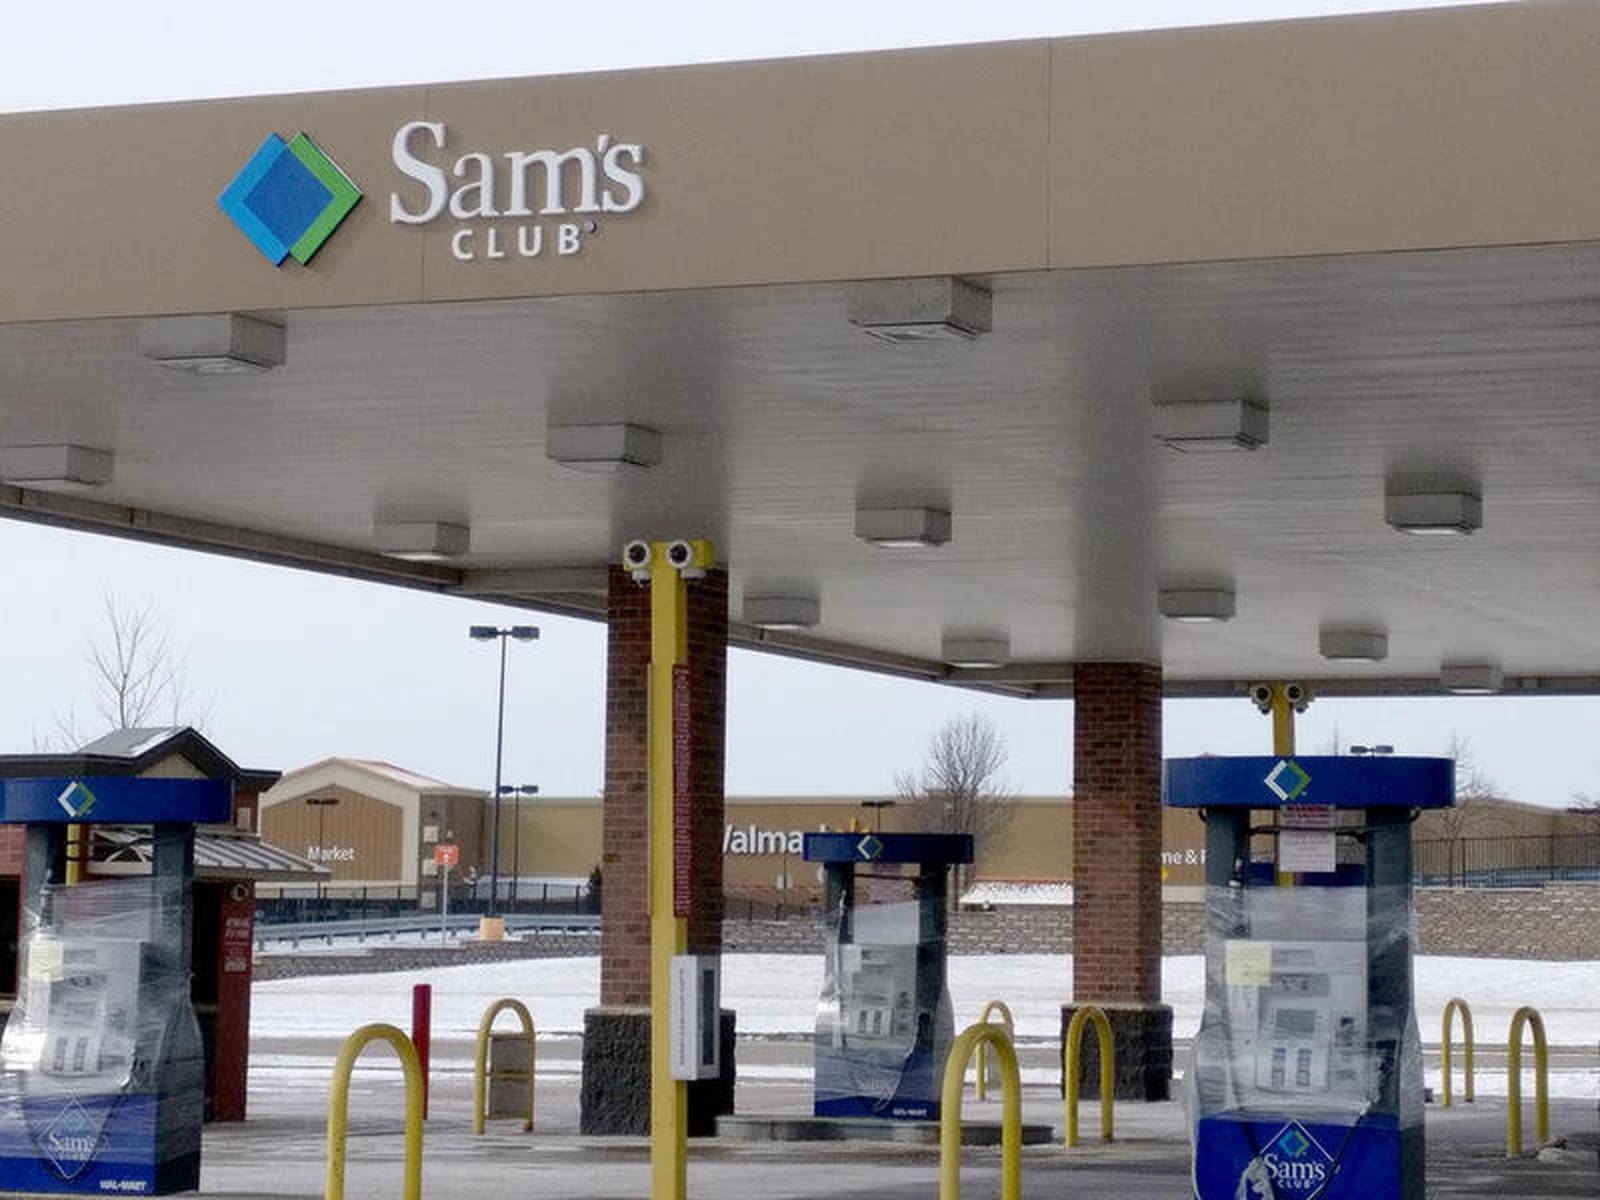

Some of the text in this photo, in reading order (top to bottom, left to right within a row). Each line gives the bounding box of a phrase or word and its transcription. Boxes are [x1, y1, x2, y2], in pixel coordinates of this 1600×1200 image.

[390, 120, 644, 224] Sam's
[451, 224, 581, 260] CLUB
[307, 846, 355, 862] Market
[1185, 848, 1198, 865] &
[1263, 1153, 1326, 1180] Sam's
